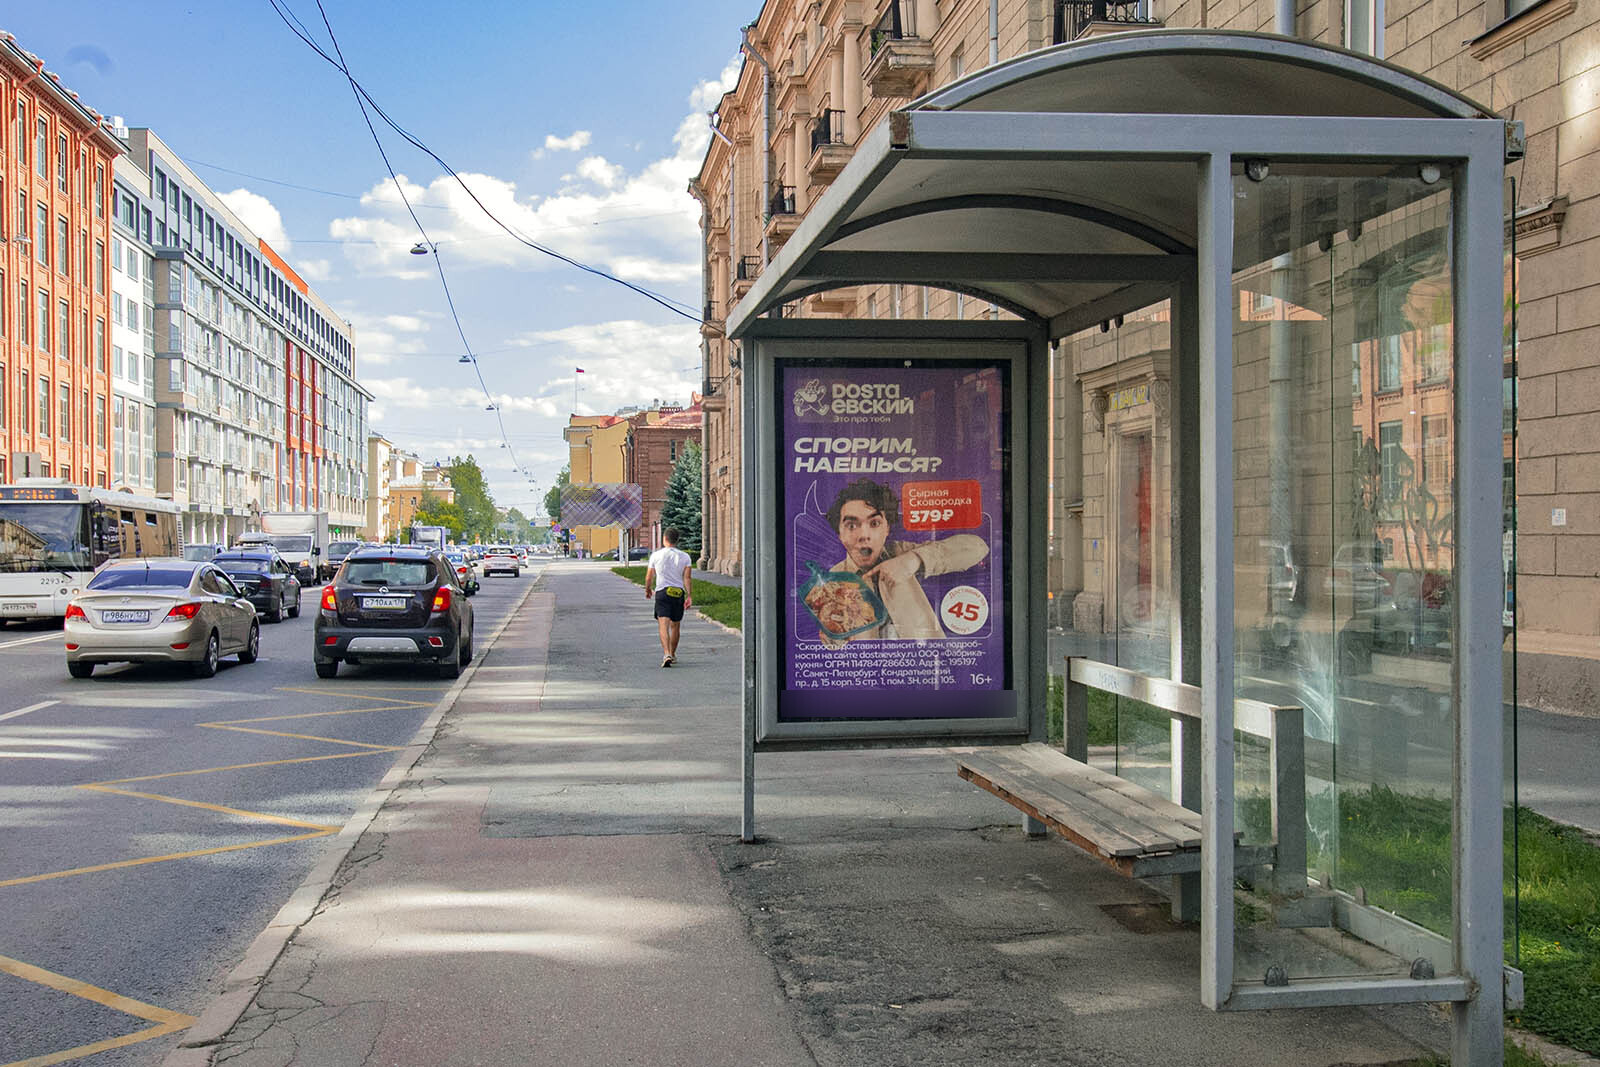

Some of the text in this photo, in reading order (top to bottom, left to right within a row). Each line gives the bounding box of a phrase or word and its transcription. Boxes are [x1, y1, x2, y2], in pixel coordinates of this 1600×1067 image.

[870, 415, 891, 423] тебя
[793, 437, 917, 456] СПОРИМ,
[793, 456, 942, 473] НАЕШЬСЯ?
[908, 488, 949, 498] Сырная
[909, 496, 972, 507] Сковородка
[947, 601, 980, 622] 45
[841, 642, 880, 651] доставки
[882, 642, 915, 650] зависит
[946, 640, 983, 649] подроб-
[833, 651, 858, 660] сайте
[859, 650, 917, 660] dostaevsky.ru
[918, 649, 939, 658] ООО
[794, 662, 823, 670] кухня»
[824, 660, 850, 668] ОГРН
[855, 678, 861, 686] 5
[970, 673, 992, 685] 16+
